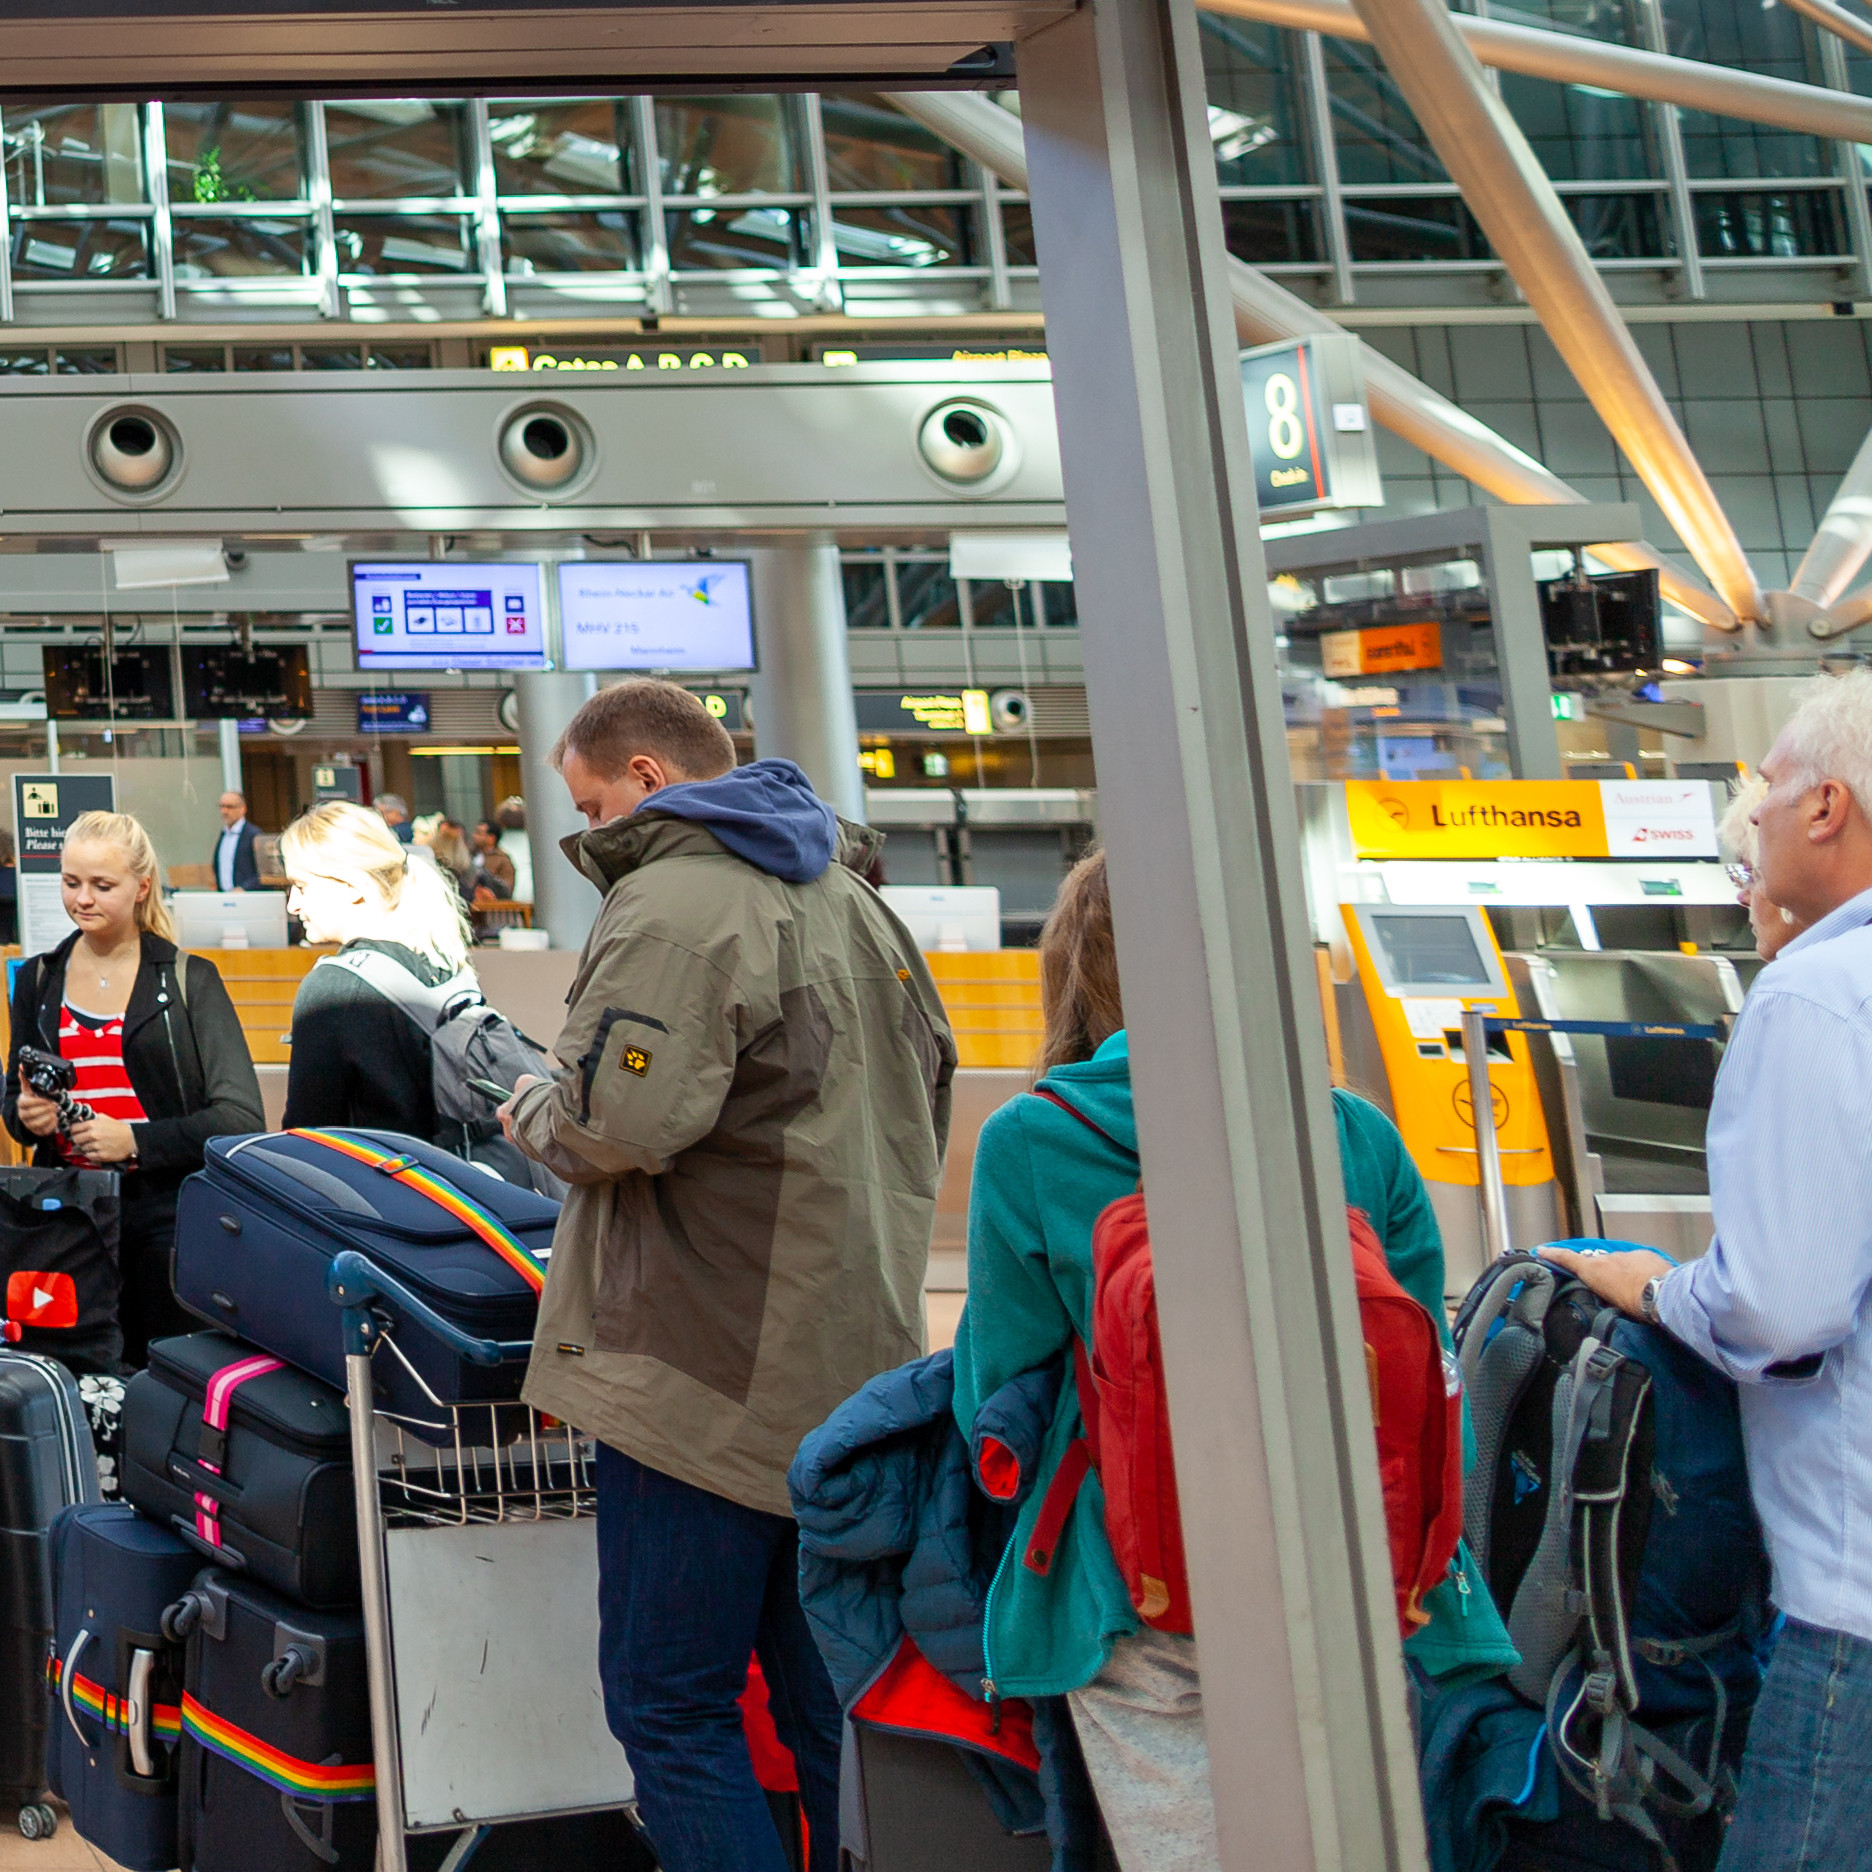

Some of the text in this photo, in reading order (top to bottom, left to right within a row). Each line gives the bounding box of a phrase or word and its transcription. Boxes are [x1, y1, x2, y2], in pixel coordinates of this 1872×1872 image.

[1264, 372, 1303, 460] 8
[1613, 792, 1674, 806] Austrian
[1432, 804, 1582, 828] Lufthansa
[25, 826, 67, 838] Bitte hie
[1651, 828, 1695, 841] SWISS
[25, 839, 58, 851] Please
